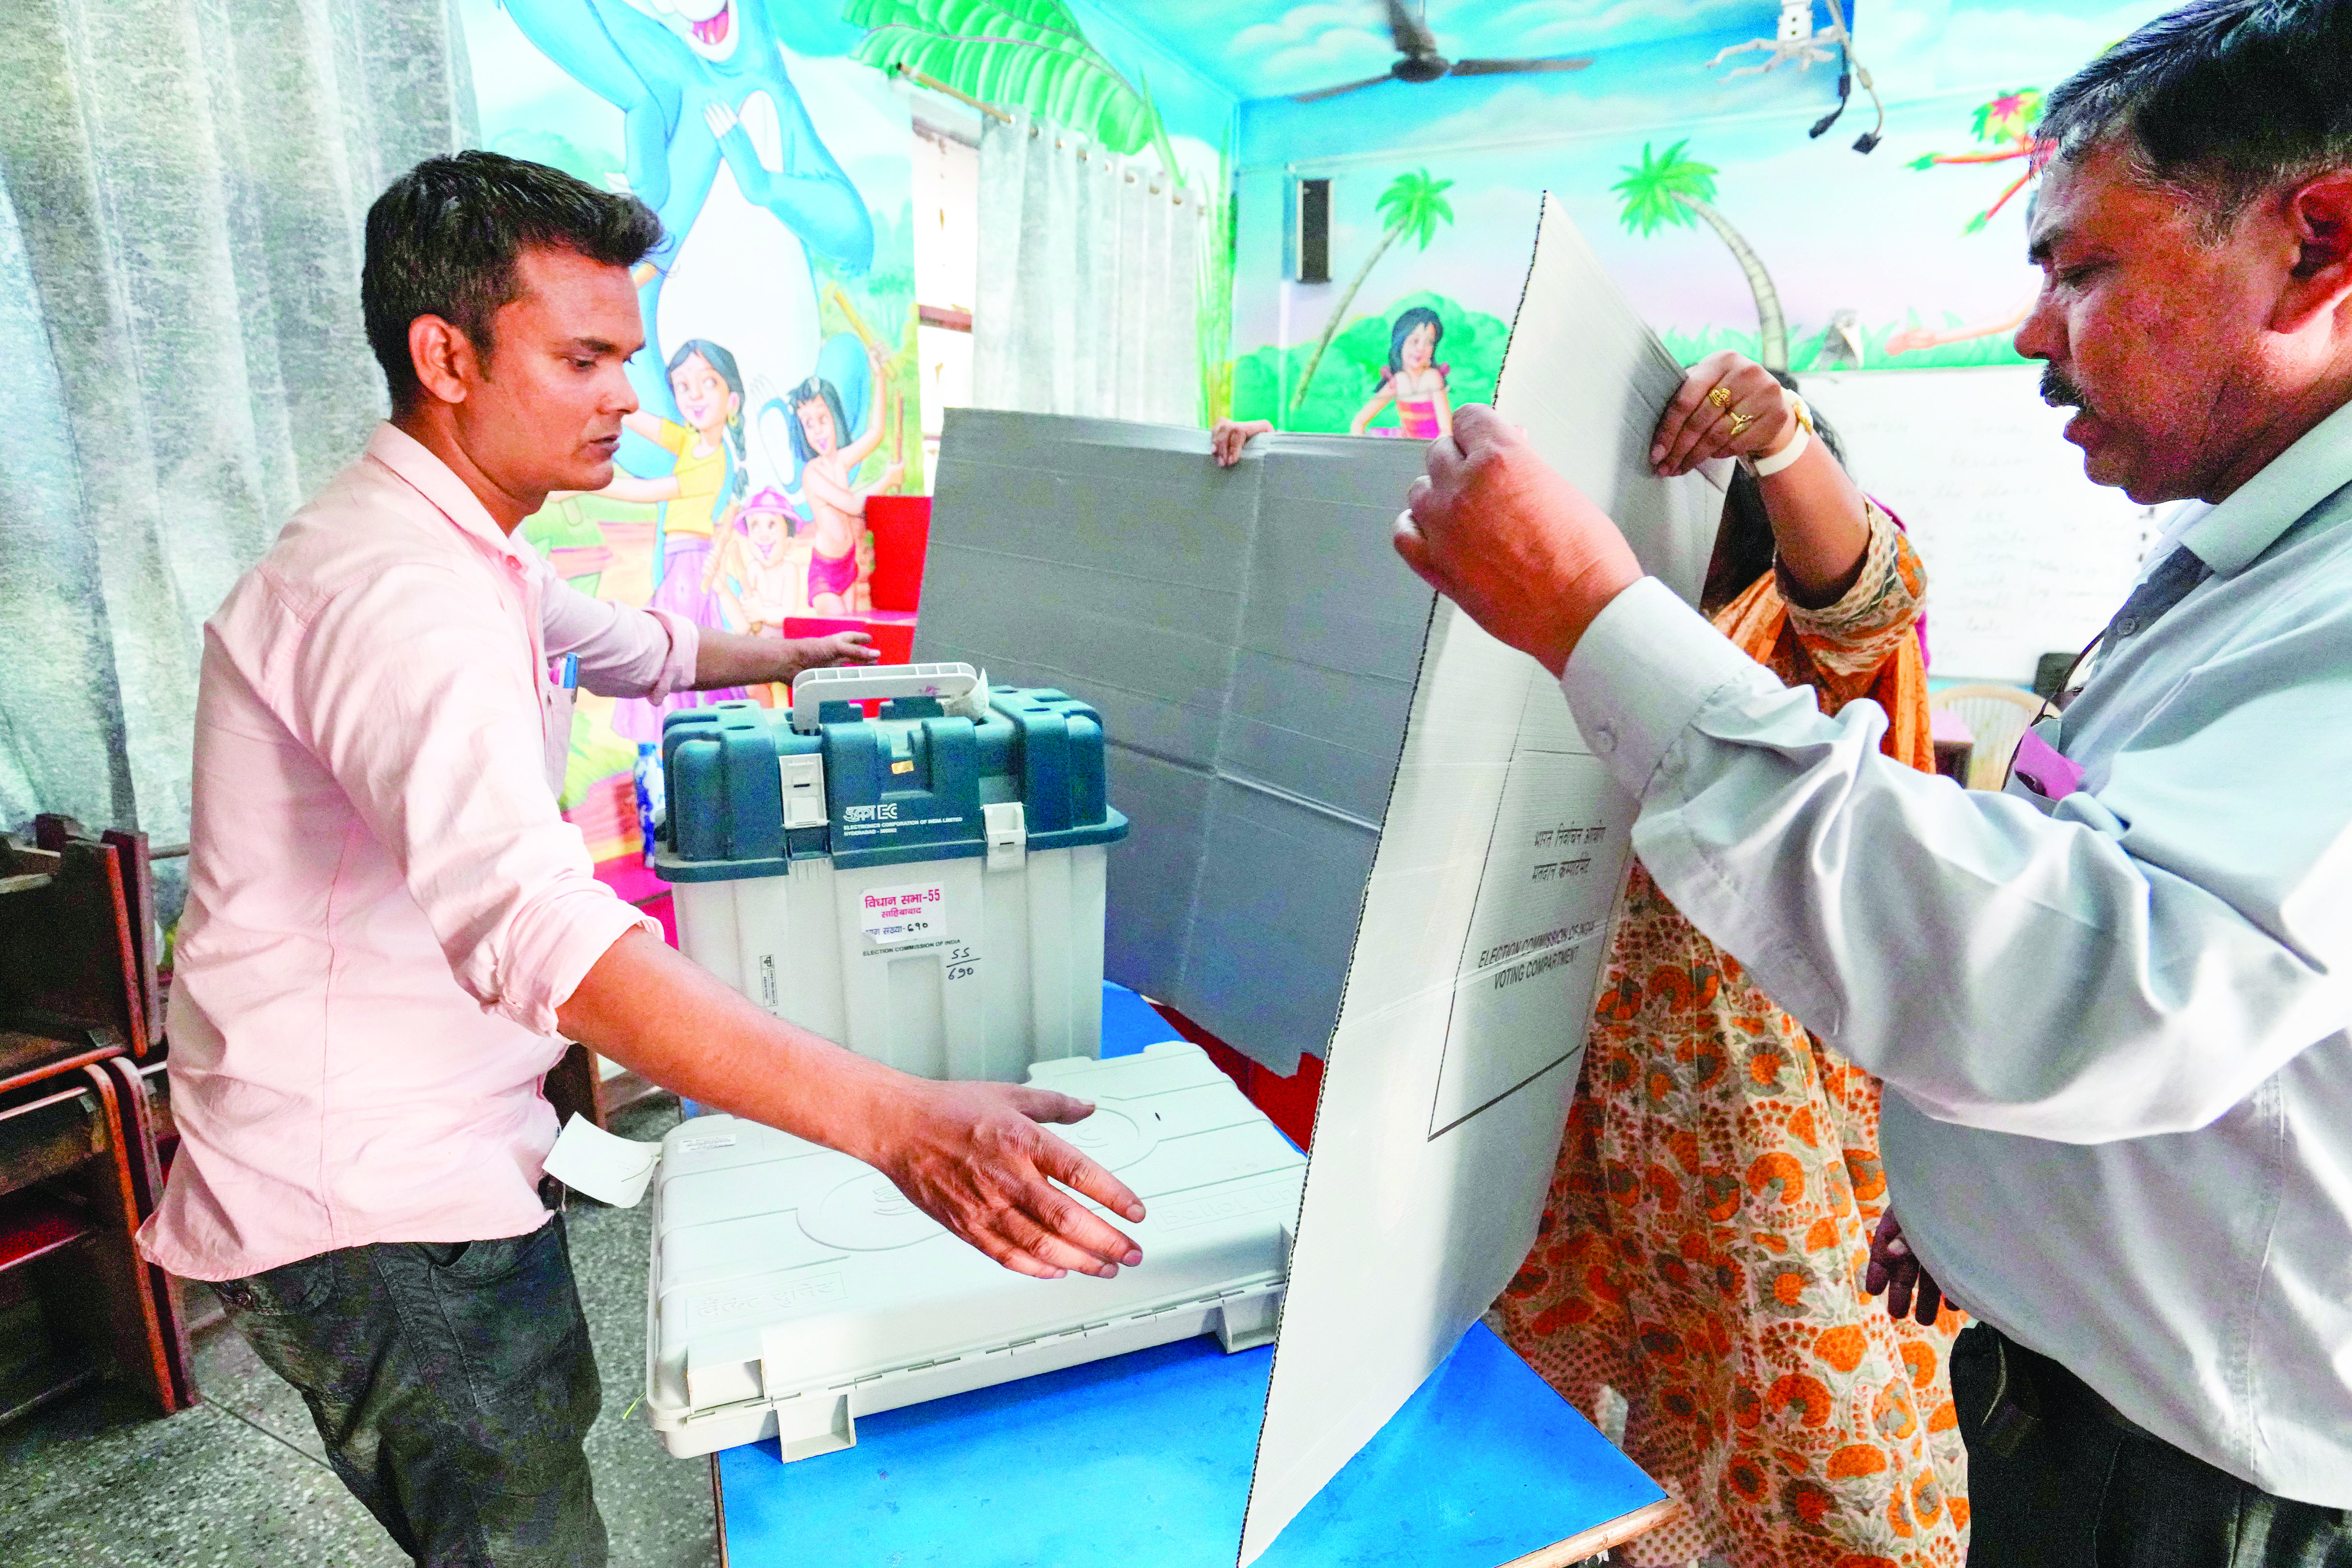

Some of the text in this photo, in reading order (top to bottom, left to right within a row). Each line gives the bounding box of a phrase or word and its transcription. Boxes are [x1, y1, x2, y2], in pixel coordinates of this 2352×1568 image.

[1534, 830, 1554, 848] भारत
[865, 895, 897, 908] विधान
[881, 907, 922, 918] साहिबाबाद
[863, 948, 893, 956] ELECTION
[895, 943, 934, 952] COMMISSION
[951, 947, 970, 959] 55
[1478, 941, 1520, 968] ELECTION
[1521, 927, 1568, 952] COMMISSION
[948, 967, 974, 980] 690
[1494, 946, 1579, 989] VOTING COMPARTMENT
[1159, 1197, 1248, 1225] Ballot
